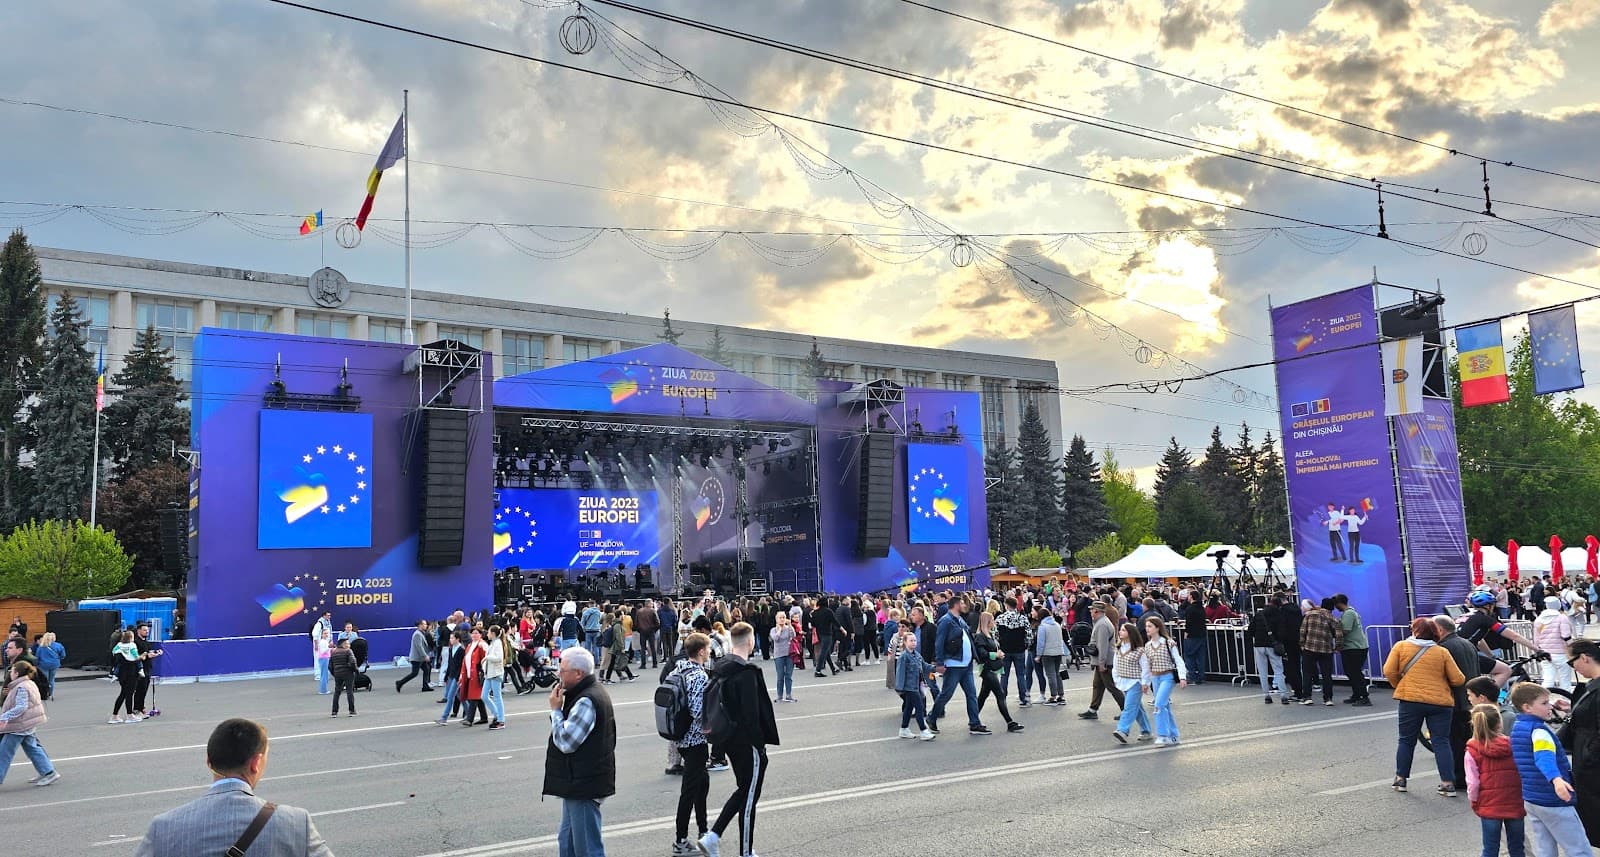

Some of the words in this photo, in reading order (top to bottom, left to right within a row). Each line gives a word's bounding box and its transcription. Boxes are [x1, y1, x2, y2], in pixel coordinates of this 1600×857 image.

[1330, 317, 1345, 326] ZIUA
[1346, 313, 1361, 322] 2023
[1330, 322, 1362, 334] EUROPEI
[662, 368, 688, 380] ZIUA
[690, 370, 716, 382] 2023
[662, 384, 716, 400] EUROPEI
[1331, 410, 1375, 423] EUROPEAN
[1293, 431, 1307, 439] DIN
[1307, 424, 1343, 437] CHIȘINĂU
[1295, 450, 1314, 458] ALEEA
[1295, 455, 1341, 466] UE-MOLDOVA:
[1296, 464, 1328, 475] ÎMPREUNĂ
[1329, 462, 1342, 470] MAI
[1343, 458, 1379, 469] PUTERNICI
[578, 496, 608, 509] ZIUA
[610, 497, 639, 509] 2023
[579, 509, 639, 523] EUROPEI
[934, 564, 949, 572] ZIUA
[336, 578, 362, 588] ZIUA
[365, 578, 392, 588] 2023
[936, 576, 966, 584] EUROPEI
[336, 592, 392, 605] EUROPEI
